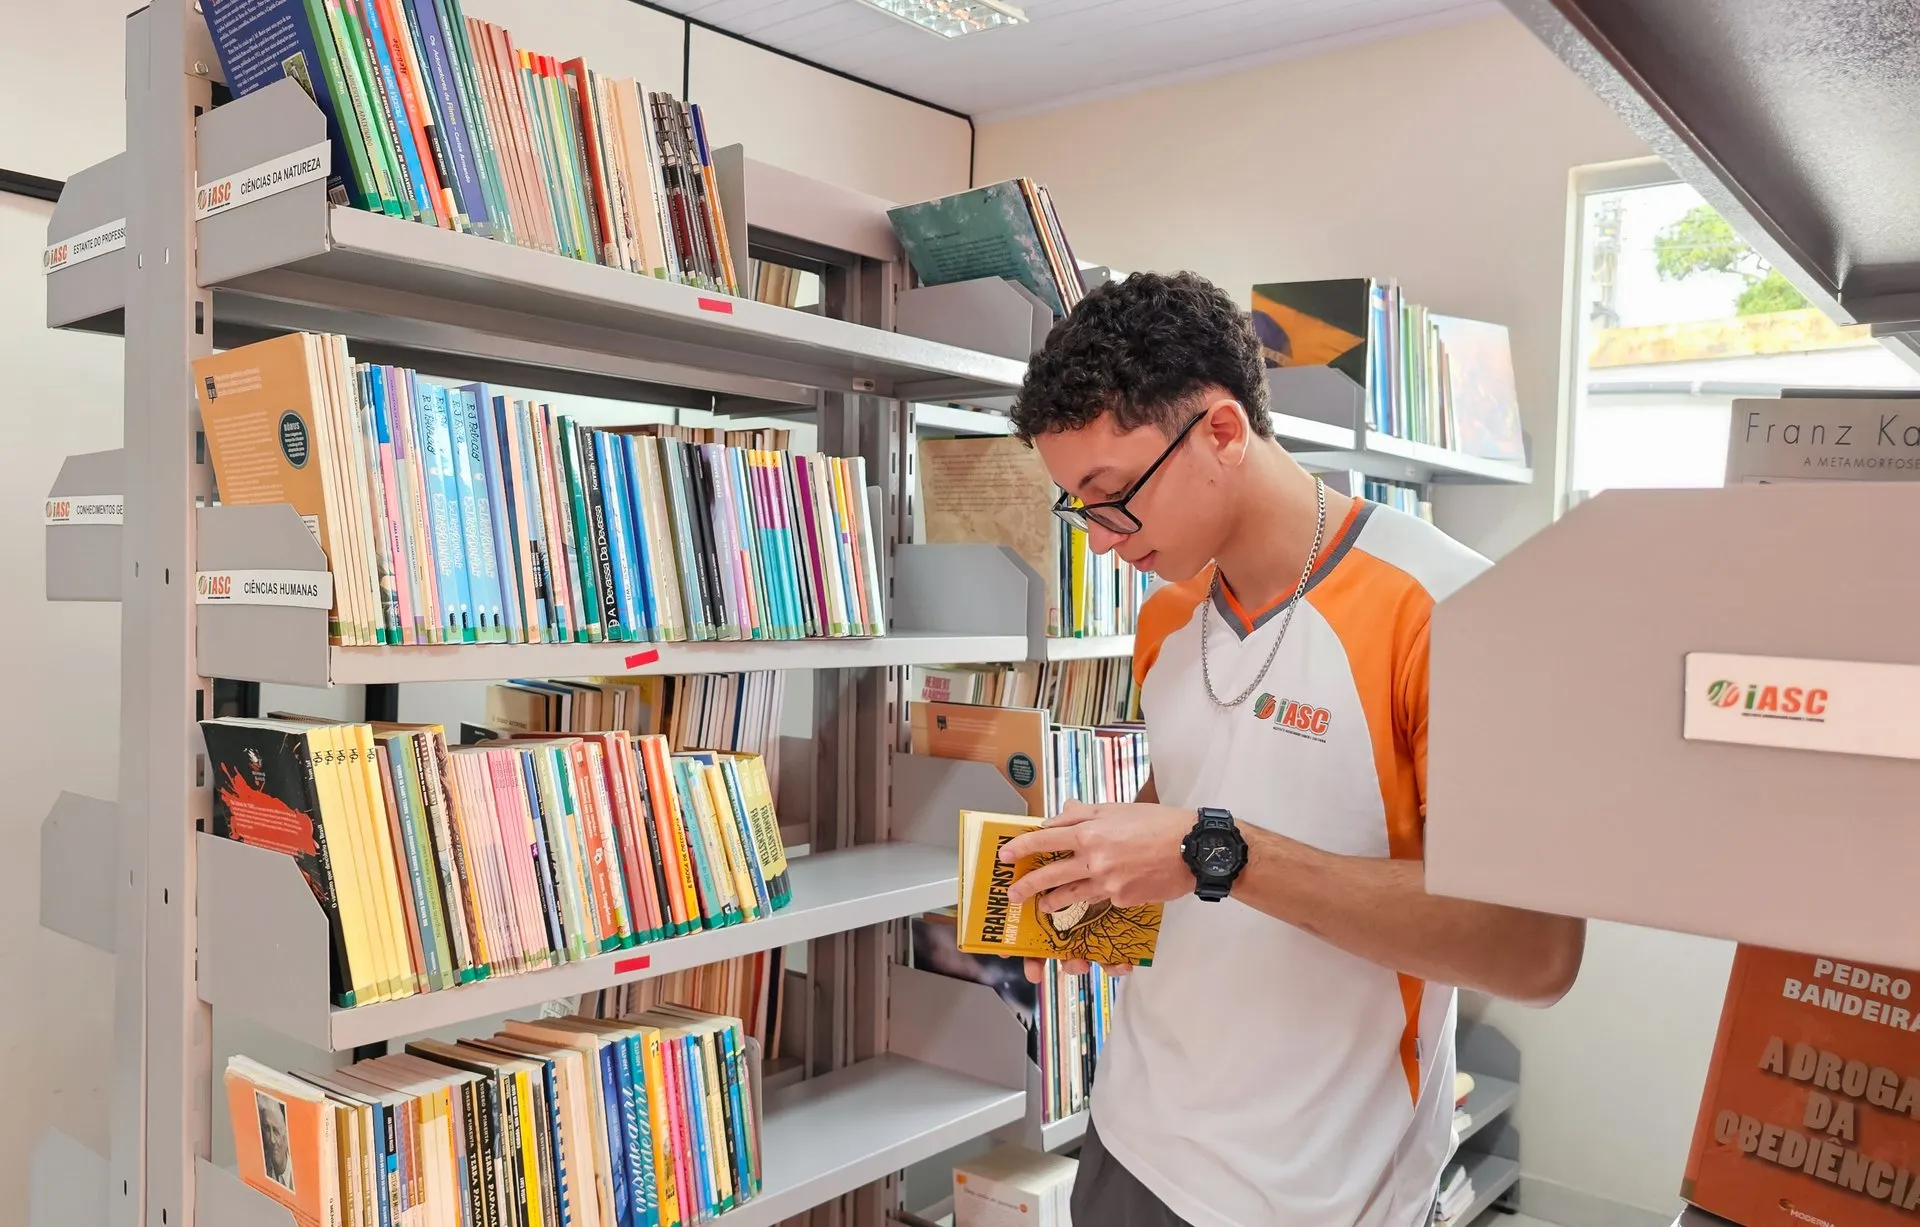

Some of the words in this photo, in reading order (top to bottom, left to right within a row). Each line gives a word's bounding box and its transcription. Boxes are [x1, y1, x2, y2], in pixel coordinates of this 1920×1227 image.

[331, 58, 341, 77] Peter
[338, 81, 346, 94] Pan
[429, 35, 435, 47] Os
[433, 49, 447, 91] Adoradores
[447, 102, 457, 125] Filmes
[454, 132, 463, 152] Carlos
[460, 153, 471, 184] Armando
[240, 173, 271, 195] CIÊNCIAS
[273, 171, 283, 184] DA
[284, 157, 321, 180] NATUREZA
[207, 181, 232, 207] iASC
[50, 244, 67, 266] iASC
[73, 239, 93, 254] ESTANTE
[94, 236, 101, 247] DO
[1745, 412, 1853, 445] Franz
[1877, 414, 1920, 447] Ka
[585, 433, 594, 461] Maxwell
[590, 462, 598, 490] Kenneth
[1804, 457, 1811, 466] A
[1817, 456, 1920, 470] METAMORFOSE
[52, 501, 70, 518] iASC
[76, 504, 115, 515] CONHECIMENTOS
[116, 504, 123, 515] GE
[595, 505, 607, 545] Devassa
[601, 547, 608, 561] Da
[208, 576, 231, 595] iASC
[243, 579, 278, 595] CIÊNCIAS
[280, 583, 318, 597] HUMANAS
[603, 562, 615, 605] Devassa
[608, 607, 617, 617] A
[1744, 684, 1828, 715] iASC
[1275, 698, 1331, 735] iASC
[322, 844, 331, 871] descobriu
[328, 882, 336, 900] vampiro
[981, 835, 1015, 943] FRANKENSTN
[1008, 902, 1023, 923] SHELL
[1004, 923, 1018, 945] MARY
[1813, 958, 1912, 1000] PEDRO
[1782, 977, 1920, 1032] BANDEIRA
[1758, 1035, 1784, 1074] A
[1790, 1042, 1920, 1117] DROGA
[1803, 1090, 1854, 1141] DA
[470, 1153, 478, 1186] TERRA
[484, 1149, 493, 1182] TERRA
[1714, 1109, 1920, 1212] OBEDIÊNCIA
